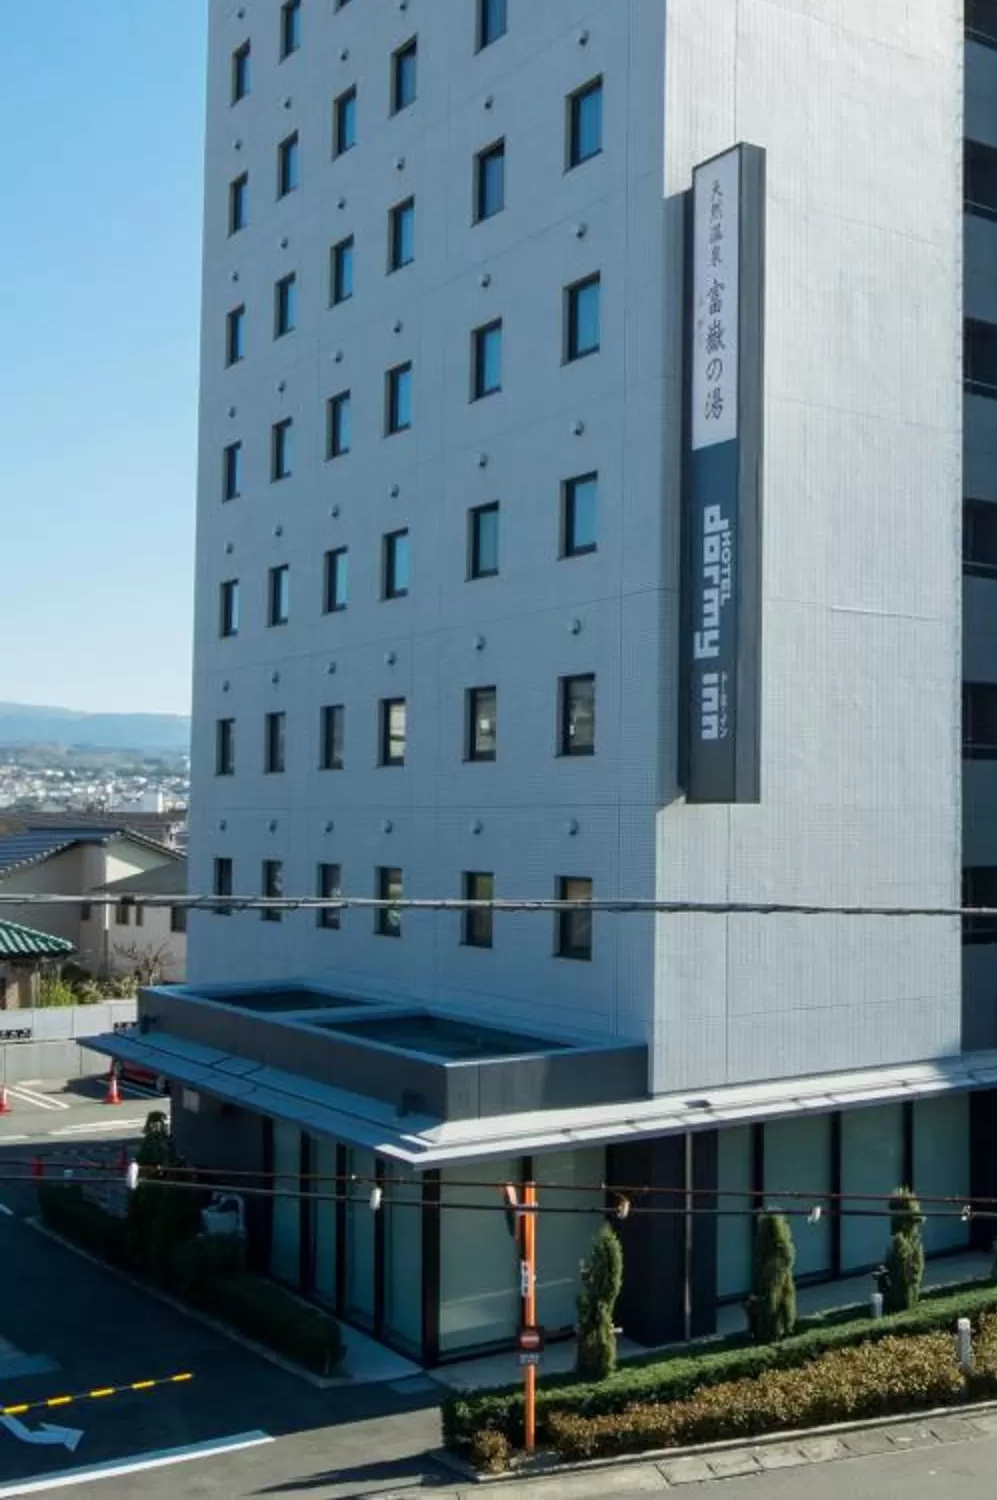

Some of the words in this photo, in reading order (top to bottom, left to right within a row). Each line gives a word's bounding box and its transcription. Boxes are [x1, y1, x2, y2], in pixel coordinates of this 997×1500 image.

[694, 504, 729, 659] dormy
[720, 530, 732, 606] HOTEL
[702, 672, 719, 740] inn
